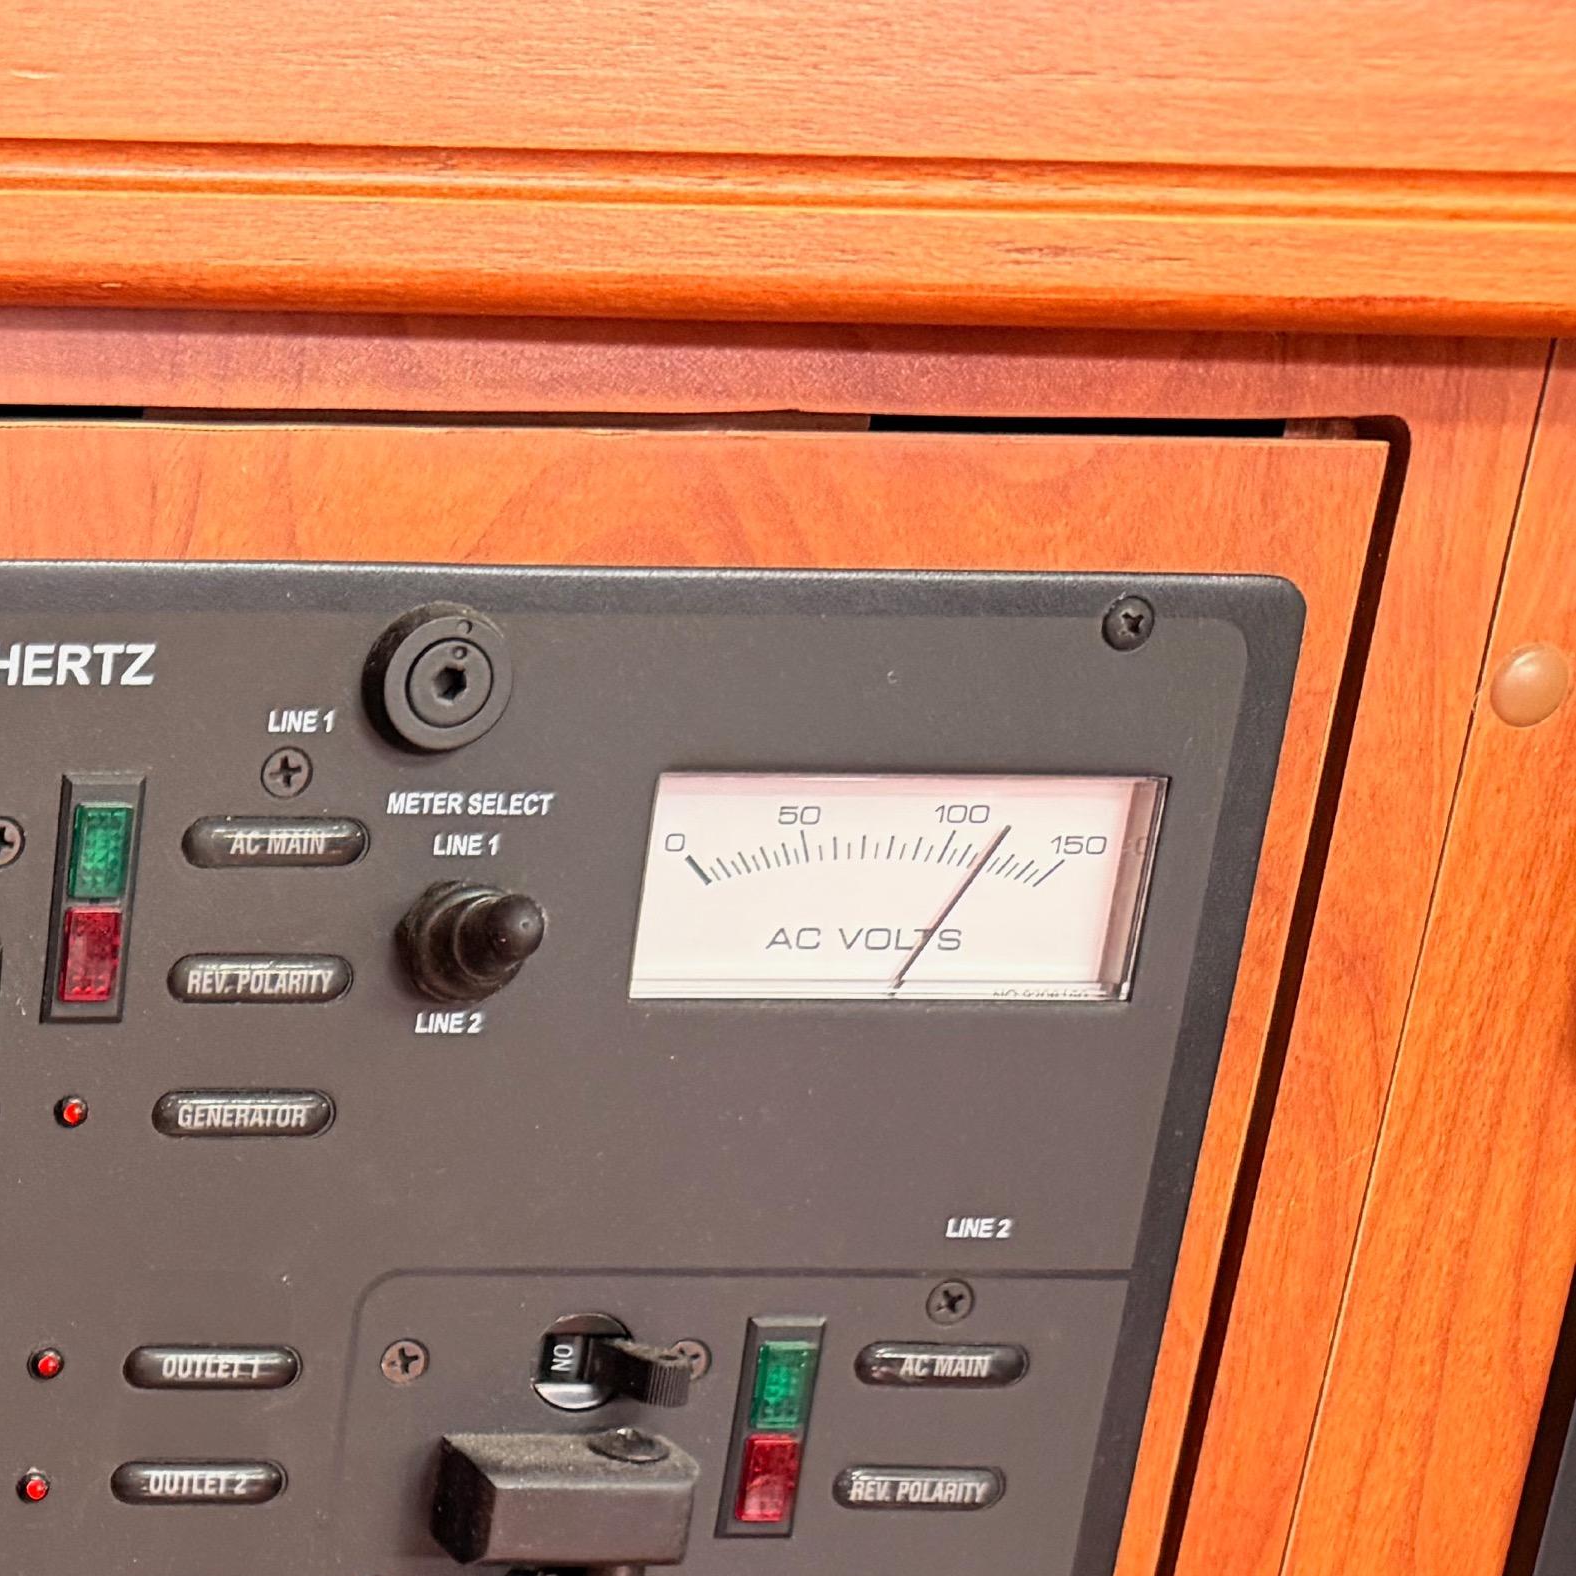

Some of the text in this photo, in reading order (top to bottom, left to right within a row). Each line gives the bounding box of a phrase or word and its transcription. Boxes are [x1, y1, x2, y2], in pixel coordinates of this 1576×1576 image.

[268, 710, 335, 733] LINE 1
[387, 792, 554, 817] METER SELECT
[664, 805, 1108, 855] 0 50 100 150
[230, 831, 325, 855] AC MAIN
[433, 834, 502, 857] LINE 1
[765, 927, 822, 950] AC
[187, 970, 334, 995] REV. POLARITY
[415, 1012, 483, 1035] LINE 2
[178, 1104, 307, 1128] GENERATOR
[945, 1217, 1013, 1240] LINE 2
[161, 1355, 261, 1379] OUTLET 1
[552, 1343, 572, 1372] ON
[900, 1356, 991, 1378] AC MAIN
[149, 1472, 248, 1495] OUTLET 2
[849, 1480, 988, 1503] REV. POLARITY
